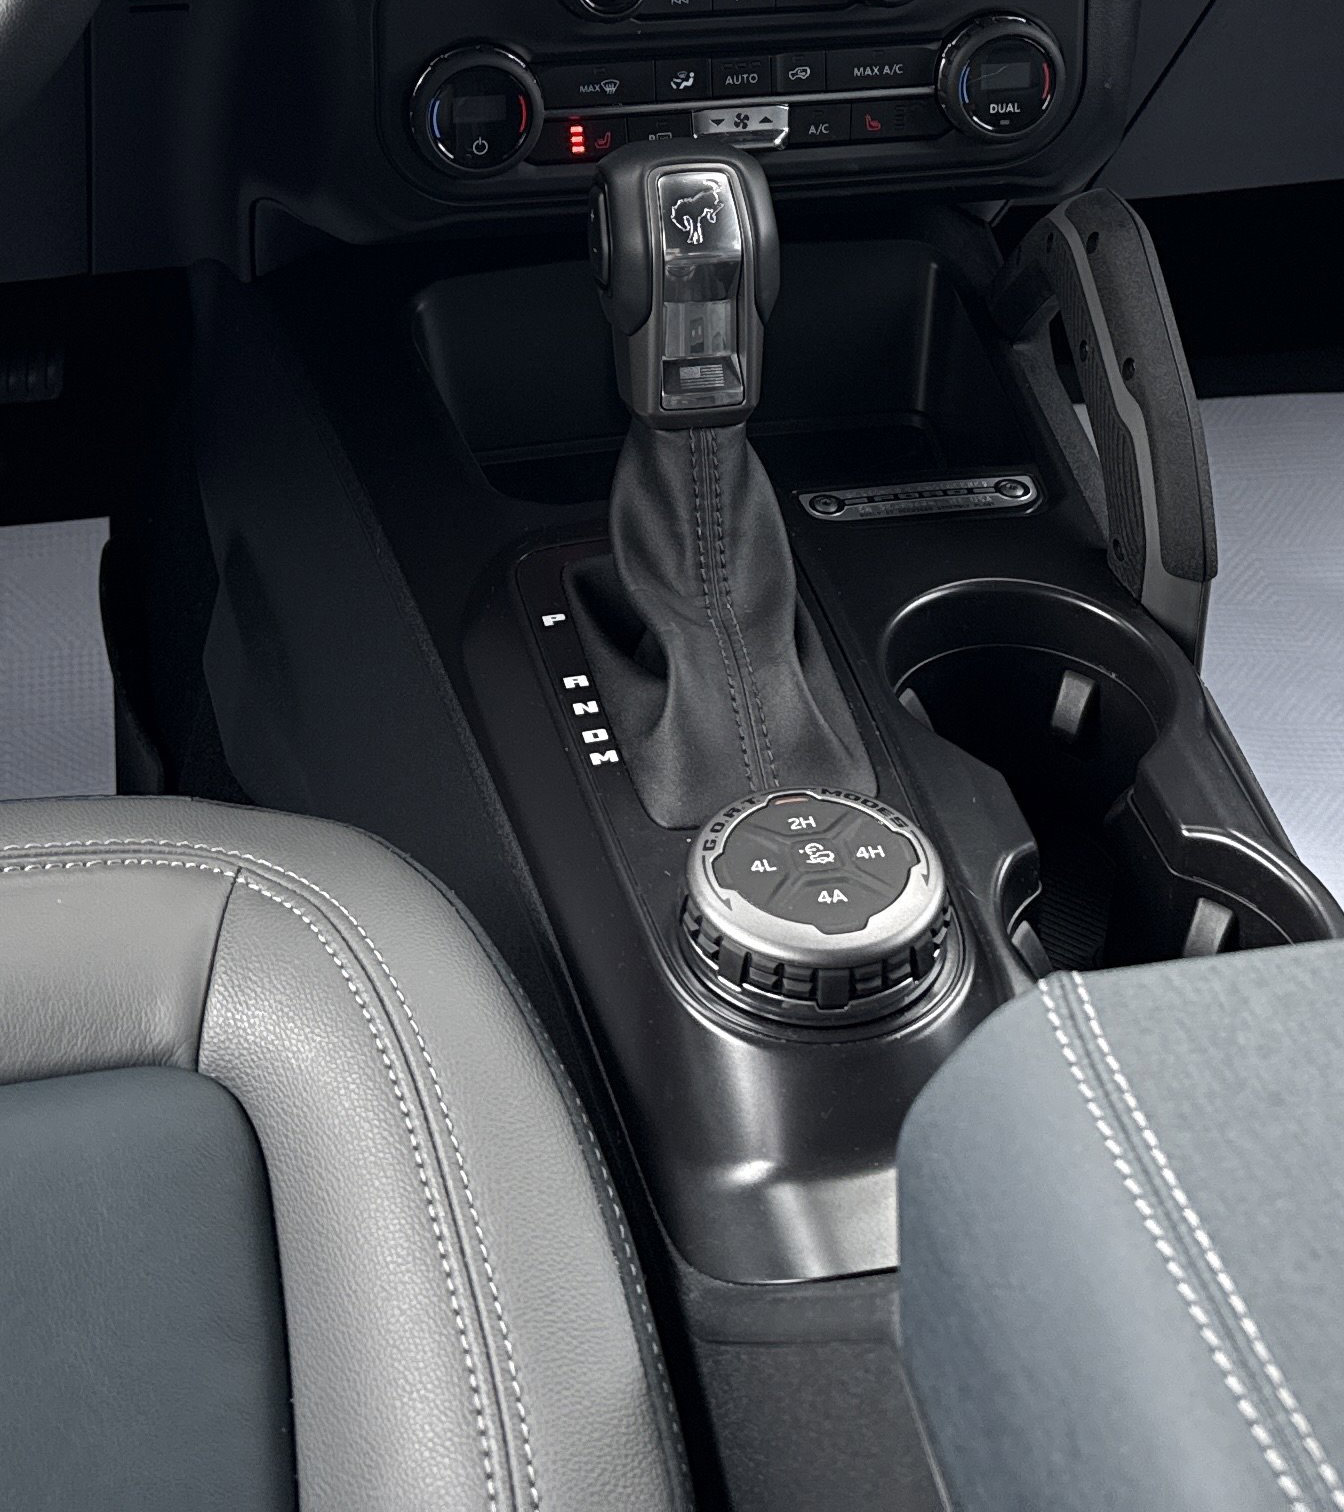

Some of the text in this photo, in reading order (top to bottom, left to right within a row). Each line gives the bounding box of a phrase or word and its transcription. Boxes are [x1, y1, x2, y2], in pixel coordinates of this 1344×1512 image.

[853, 63, 904, 77] MAX A/C
[725, 73, 759, 85] AUTO
[579, 84, 601, 93] MAX
[989, 102, 1021, 115] DUAL
[808, 123, 830, 135] A/C
[542, 613, 566, 627] P
[573, 701, 599, 715] N
[582, 728, 609, 744] D
[589, 749, 619, 766] M
[821, 788, 909, 828] MODES
[787, 816, 817, 830] 2H
[856, 845, 886, 860] 4H
[751, 859, 777, 873] 4L
[817, 889, 849, 904] 4A
